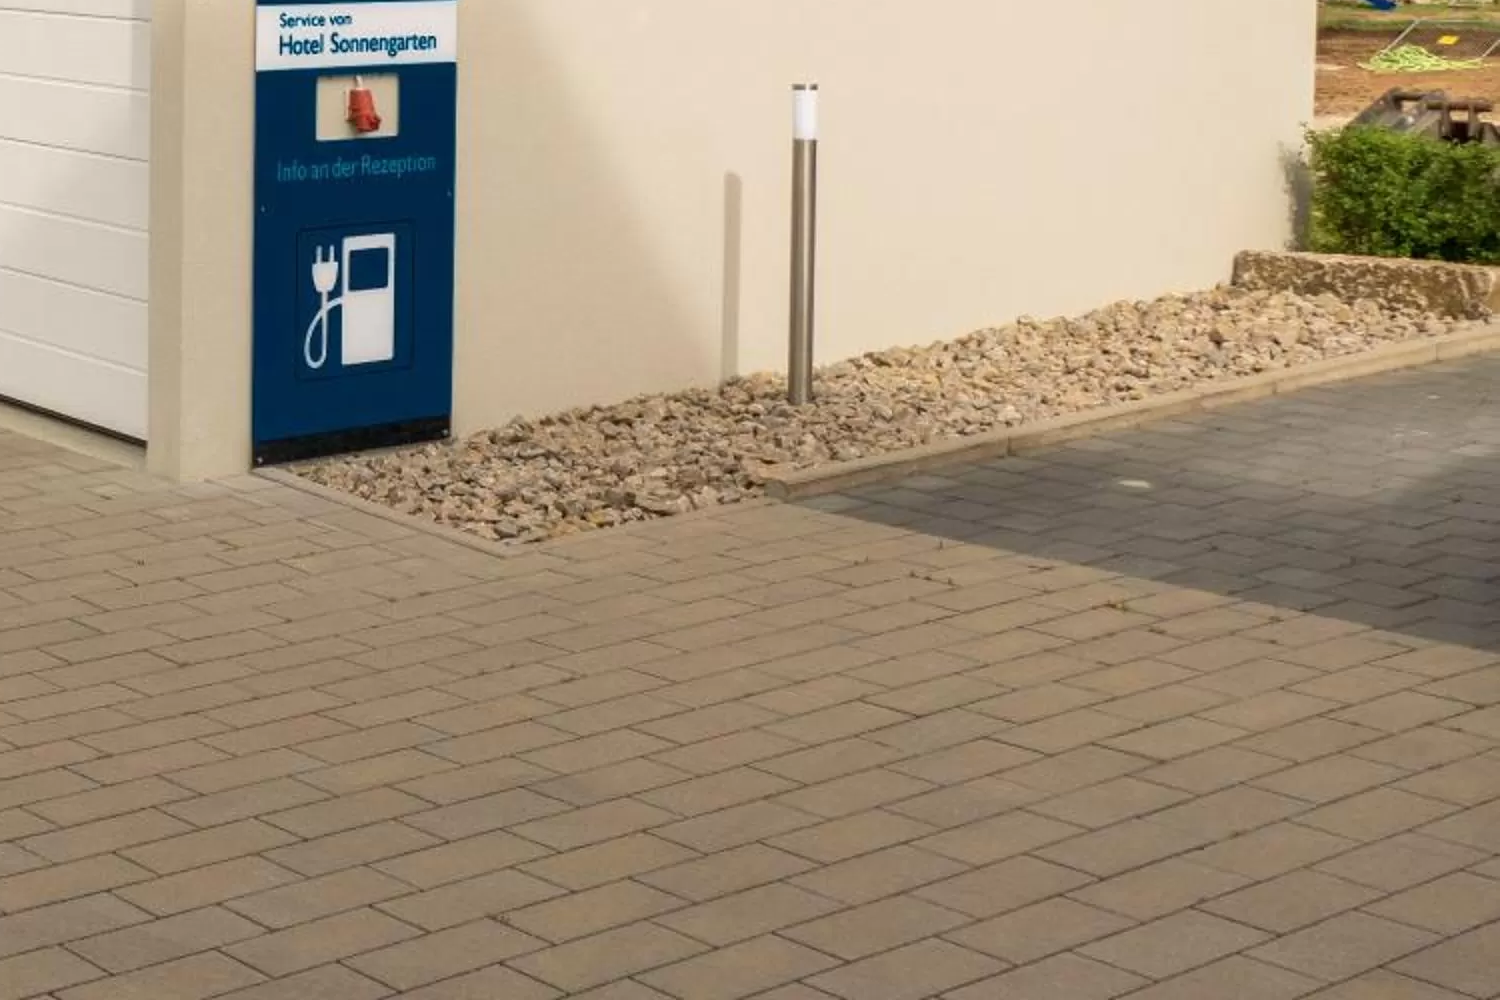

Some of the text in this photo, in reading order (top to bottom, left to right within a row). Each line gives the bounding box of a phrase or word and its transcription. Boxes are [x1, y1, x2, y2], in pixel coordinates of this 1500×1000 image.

[279, 12, 353, 29] Service von
[279, 32, 437, 57] Hotel Sonnengarten
[277, 154, 437, 182] Info an der Rezeption
